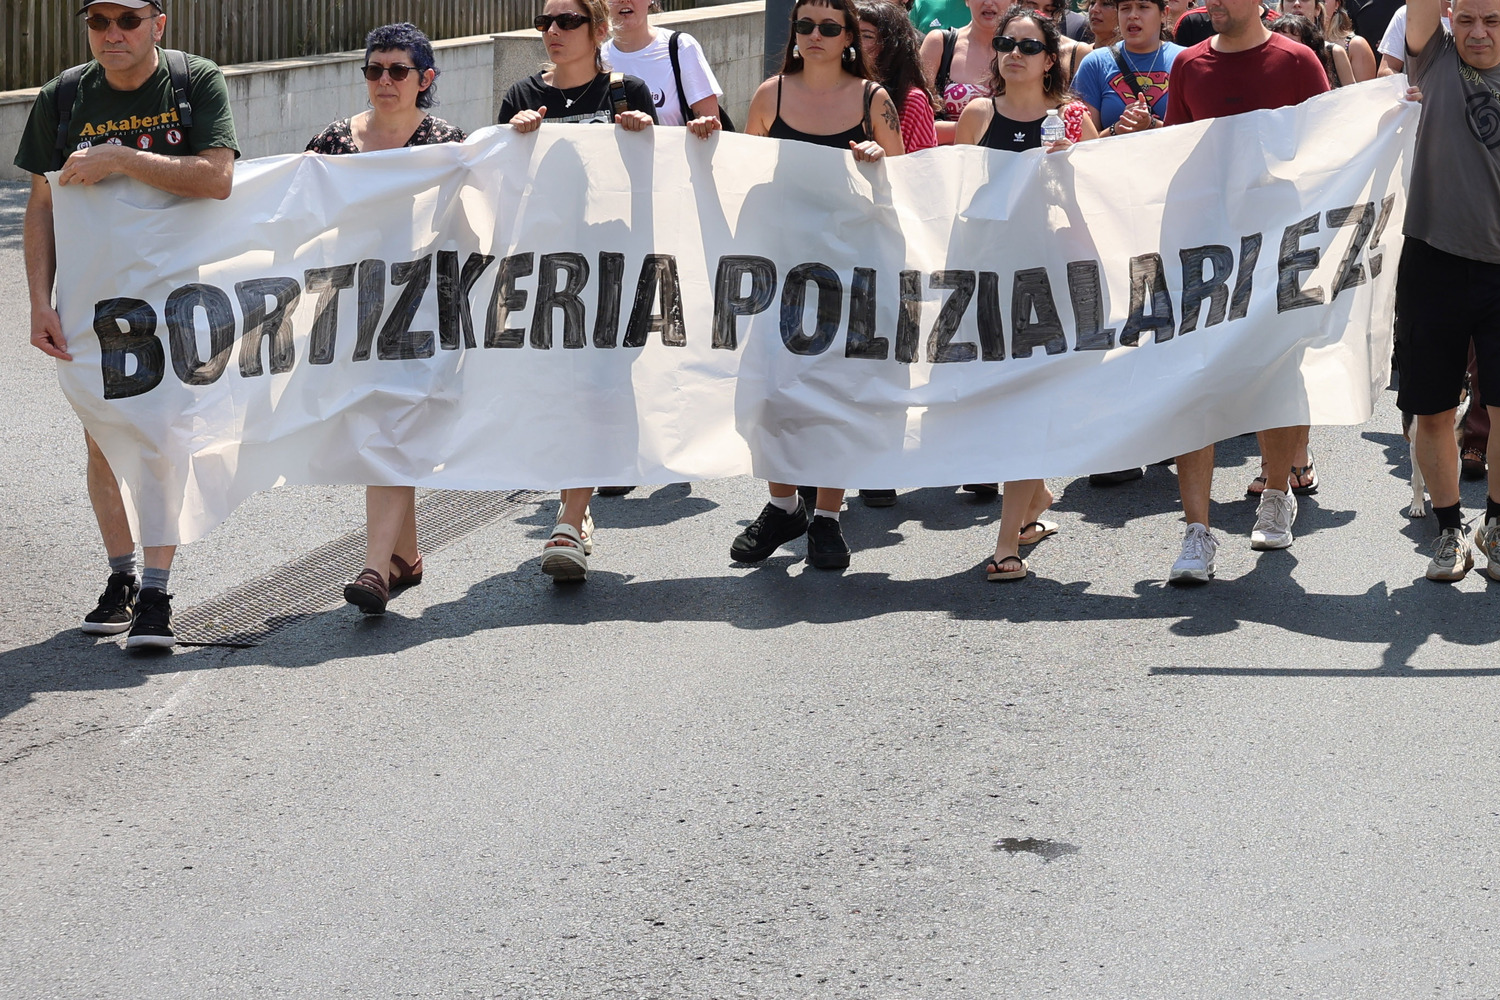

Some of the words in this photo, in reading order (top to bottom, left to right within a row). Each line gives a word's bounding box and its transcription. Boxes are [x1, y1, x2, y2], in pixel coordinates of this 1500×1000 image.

[79, 107, 179, 137] Askaberri
[91, 249, 680, 400] BORTIZKERIA
[711, 233, 1262, 363] POLIZIALARI
[1276, 192, 1396, 315] EZ!
